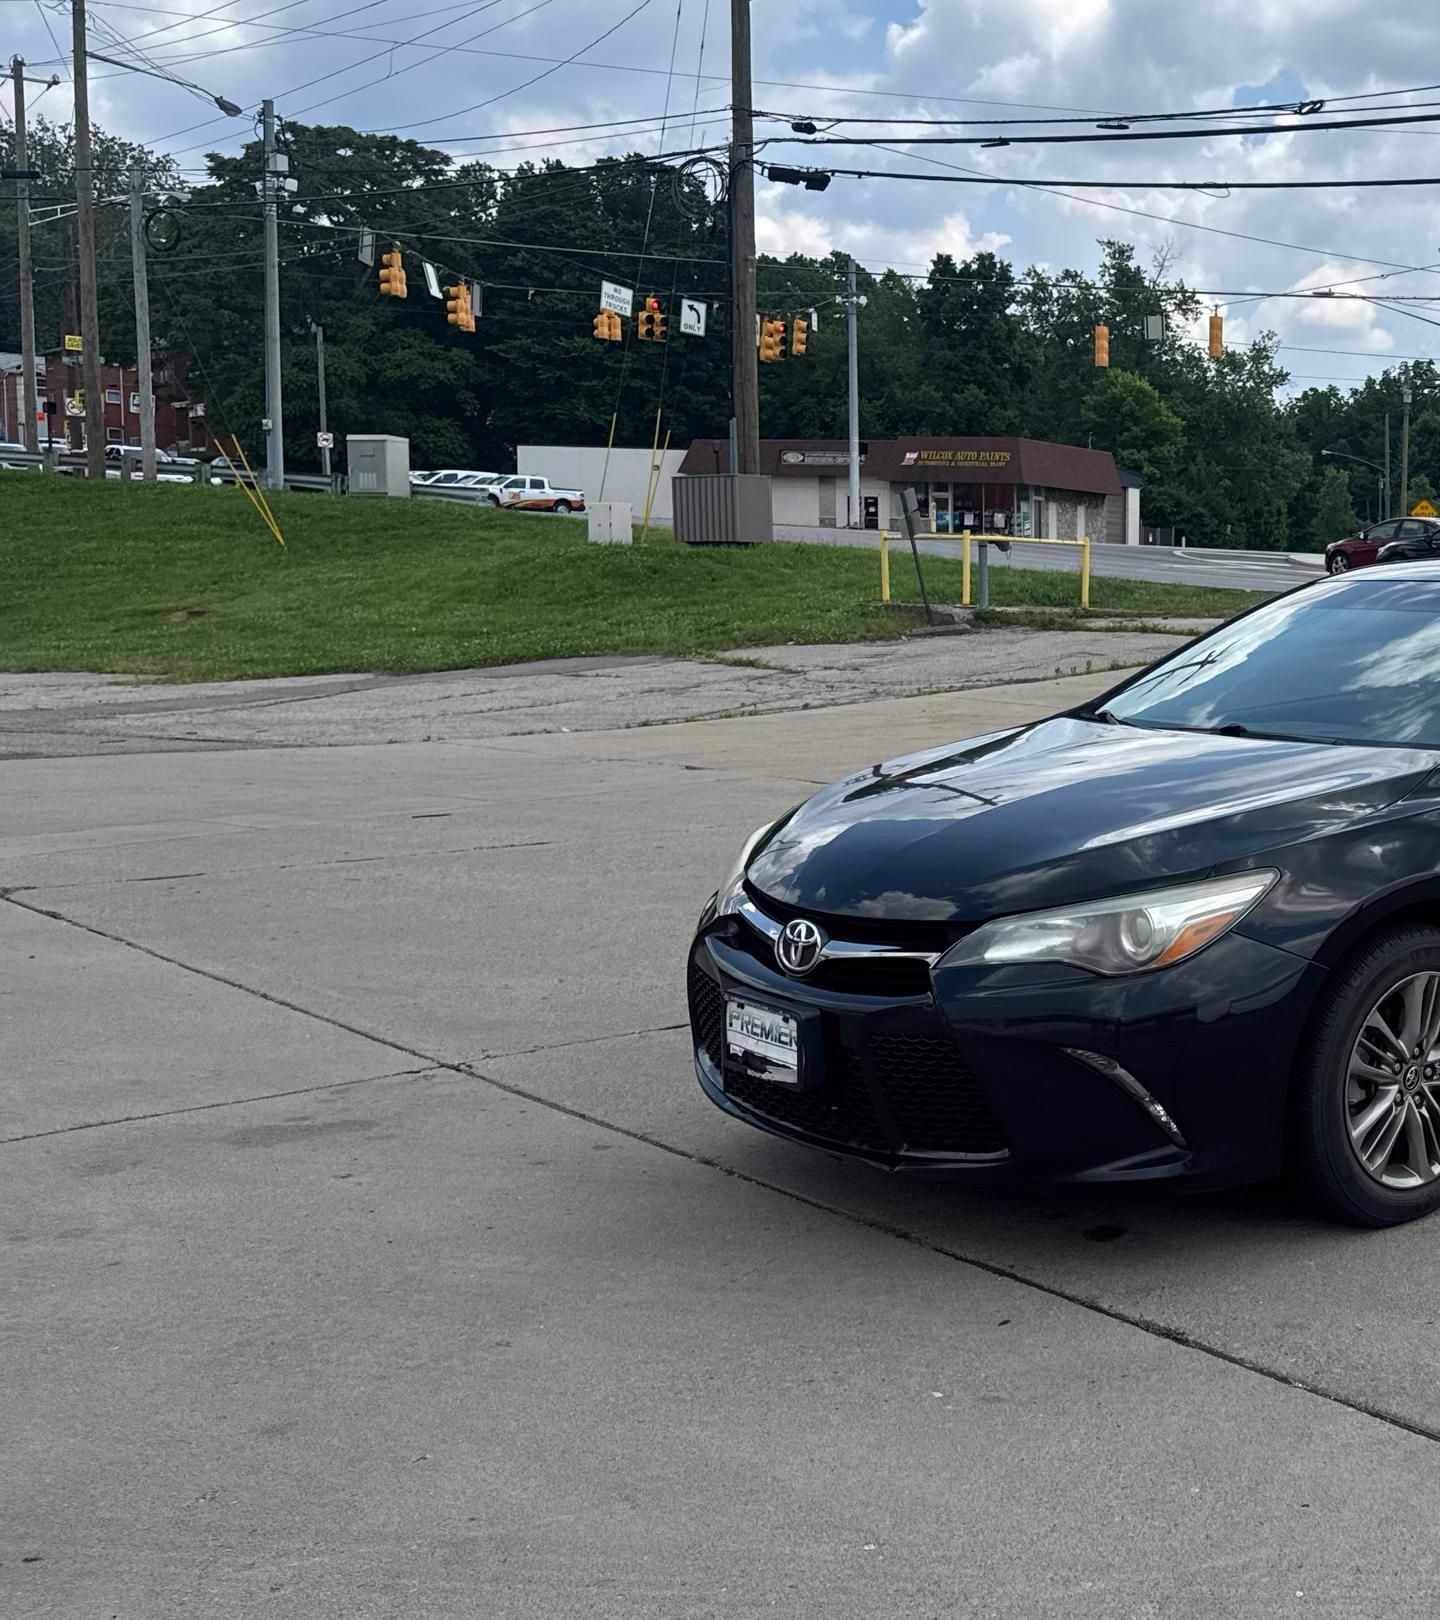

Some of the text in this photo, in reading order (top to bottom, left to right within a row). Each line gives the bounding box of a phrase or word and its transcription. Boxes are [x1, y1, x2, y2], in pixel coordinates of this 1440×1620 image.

[603, 292, 630, 306] THROUGH
[605, 301, 628, 314] TRUCKS
[683, 323, 701, 332] ONLY
[920, 450, 953, 460] WILCOX
[955, 451, 977, 461] AUTO
[980, 452, 1011, 462] PAINTS
